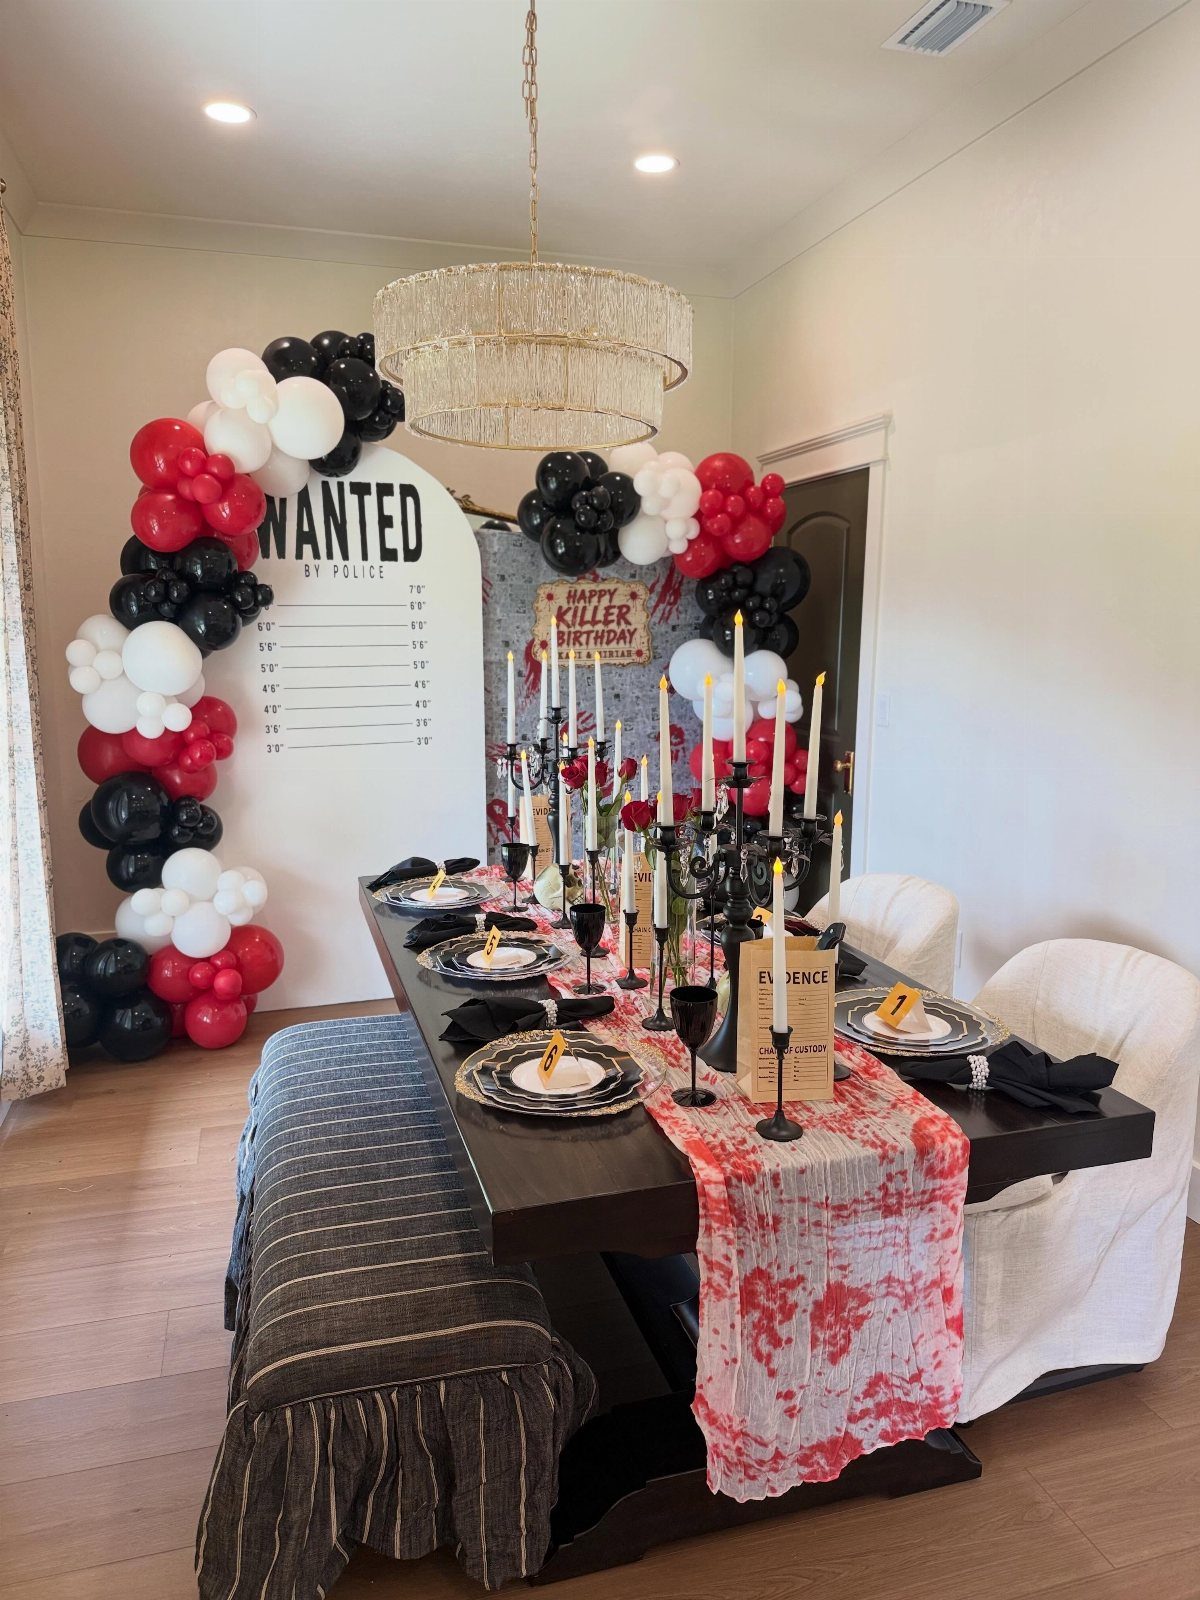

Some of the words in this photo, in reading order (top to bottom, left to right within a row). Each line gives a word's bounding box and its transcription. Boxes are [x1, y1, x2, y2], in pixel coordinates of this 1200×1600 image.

[257, 481, 422, 562] WANTED
[304, 564, 321, 578] BY
[332, 564, 385, 579] POLICE
[566, 587, 618, 605] HAPPY
[555, 604, 632, 629] KILLER
[557, 628, 637, 648] BIRTHDAY
[486, 934, 497, 956] 5
[759, 970, 829, 985] EVDENCE
[890, 994, 908, 1016] 1
[543, 1044, 558, 1072] 6
[794, 1044, 827, 1054] CUSTODY
